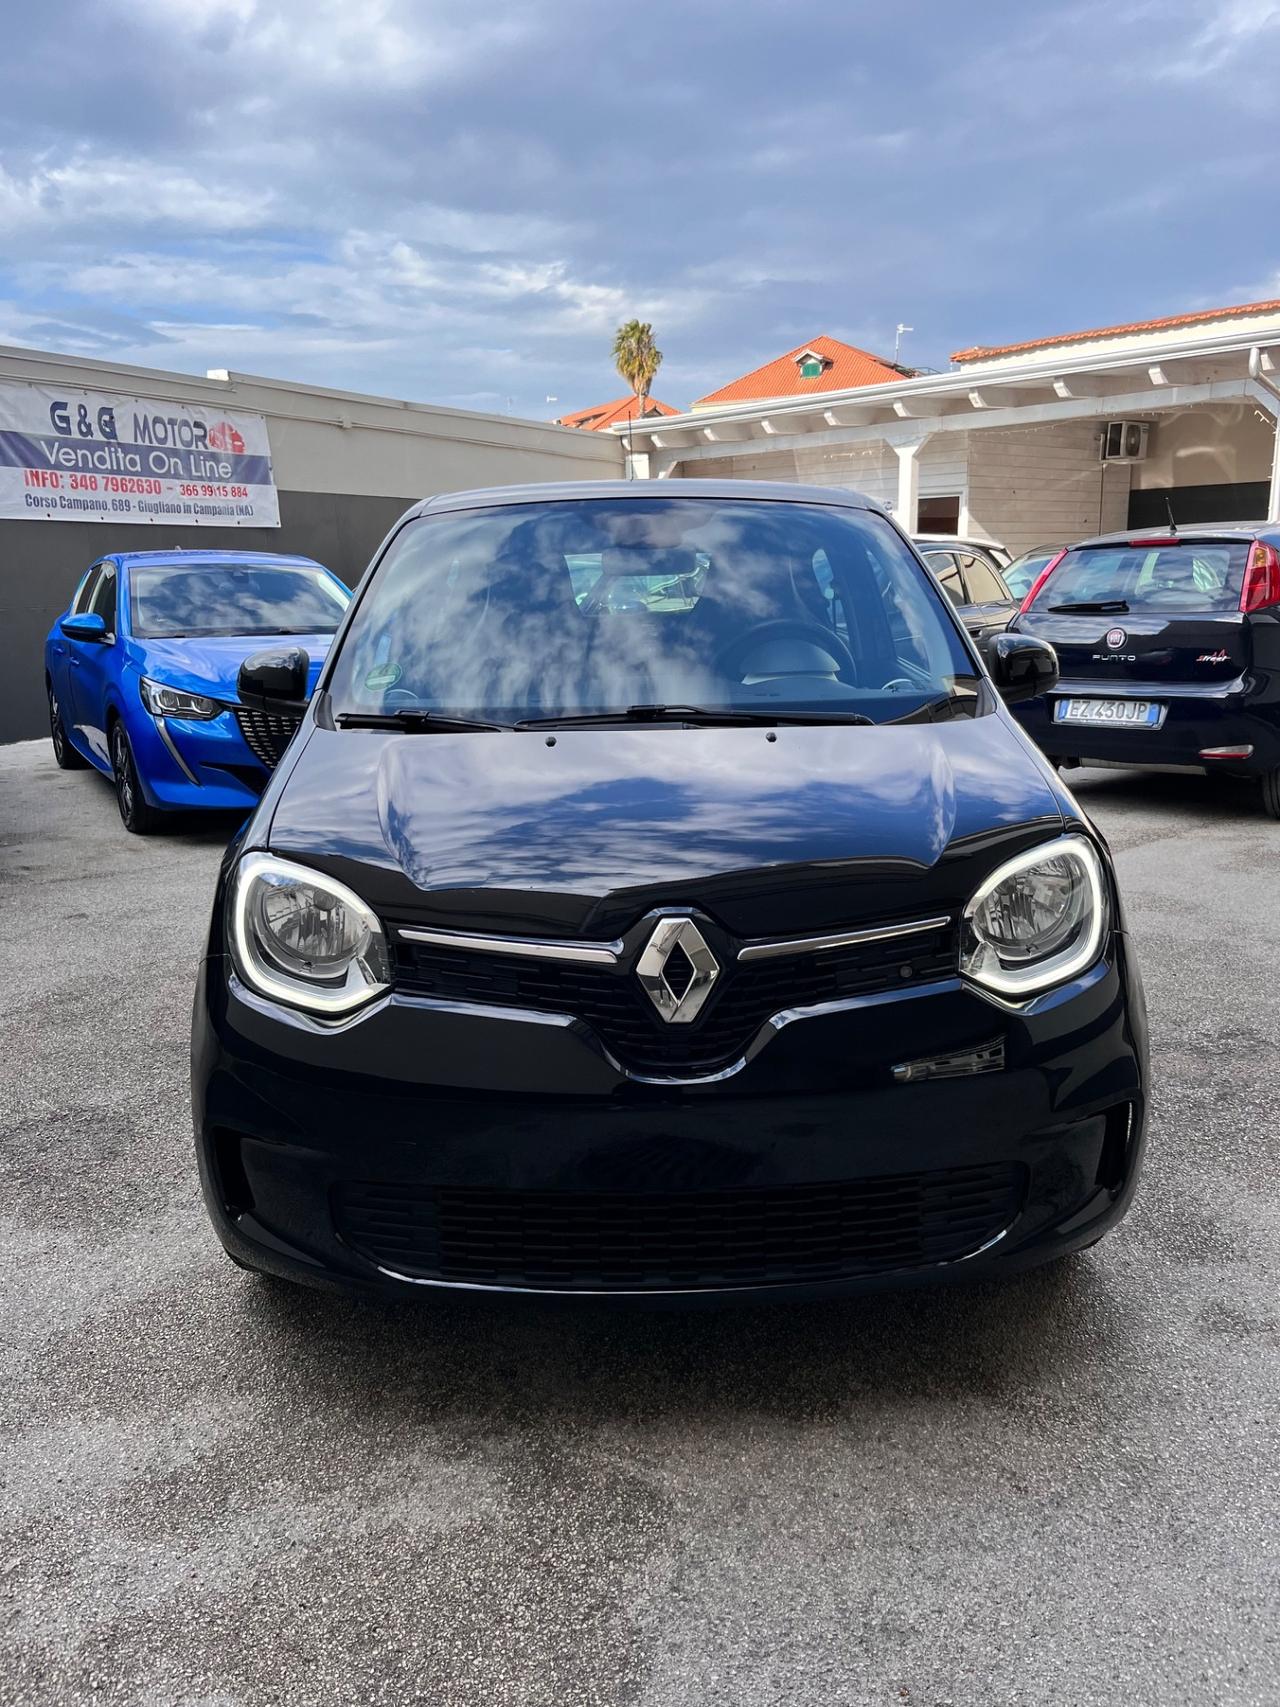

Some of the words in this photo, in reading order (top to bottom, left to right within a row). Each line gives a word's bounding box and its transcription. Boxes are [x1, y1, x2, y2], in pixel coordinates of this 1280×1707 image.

[49, 401, 119, 441] G&G
[133, 412, 209, 450] MOTOR
[40, 440, 142, 472] Vendita
[149, 451, 184, 475] On
[190, 454, 233, 479] Line
[24, 469, 65, 489] INFO:
[101, 475, 162, 495] 7962630
[179, 484, 199, 497] 366
[230, 486, 248, 498] 884
[25, 493, 58, 509] Corso
[111, 498, 131, 512] 689
[137, 500, 182, 515] Giugliano
[183, 502, 192, 515] in
[193, 502, 235, 517] Campania
[235, 504, 254, 517] (NA)
[1070, 700, 1091, 718] EZ
[1094, 702, 1148, 720] 430JP
